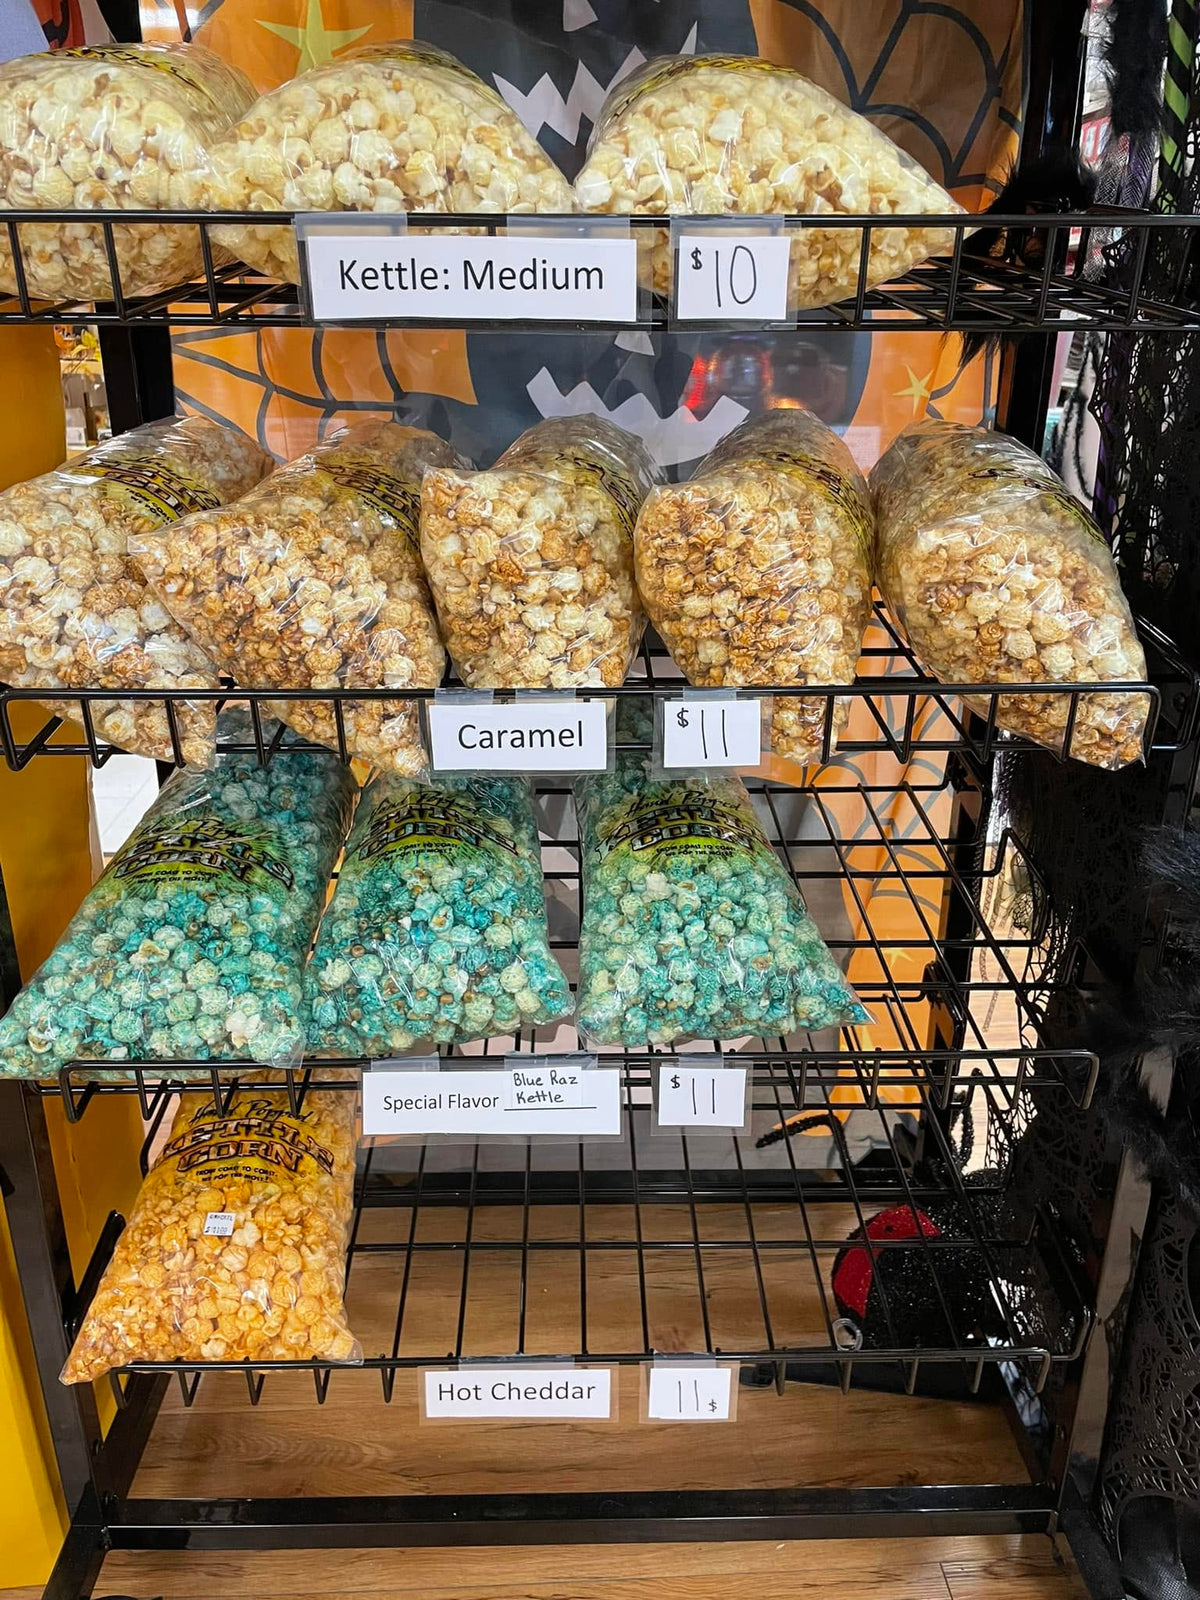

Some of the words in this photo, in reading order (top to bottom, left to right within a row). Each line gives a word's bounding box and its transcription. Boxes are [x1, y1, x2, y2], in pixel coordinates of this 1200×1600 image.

[339, 257, 450, 291] Kettle:
[463, 257, 604, 291] Medium
[690, 245, 757, 308] $10
[458, 720, 583, 750] Caramel
[676, 707, 729, 760] $11
[624, 793, 674, 817] Hand
[677, 790, 741, 812] Popped
[513, 1072, 544, 1087] Blue
[549, 1069, 578, 1086] Raz
[383, 1094, 442, 1114] Special
[448, 1093, 500, 1109] Flavor
[516, 1090, 564, 1104] Kettle
[670, 1074, 716, 1115] $11
[160, 1117, 335, 1176] KETTLE
[176, 1140, 303, 1173] CORN
[438, 1383, 482, 1402] Hot
[491, 1381, 596, 1401] Cheddar
